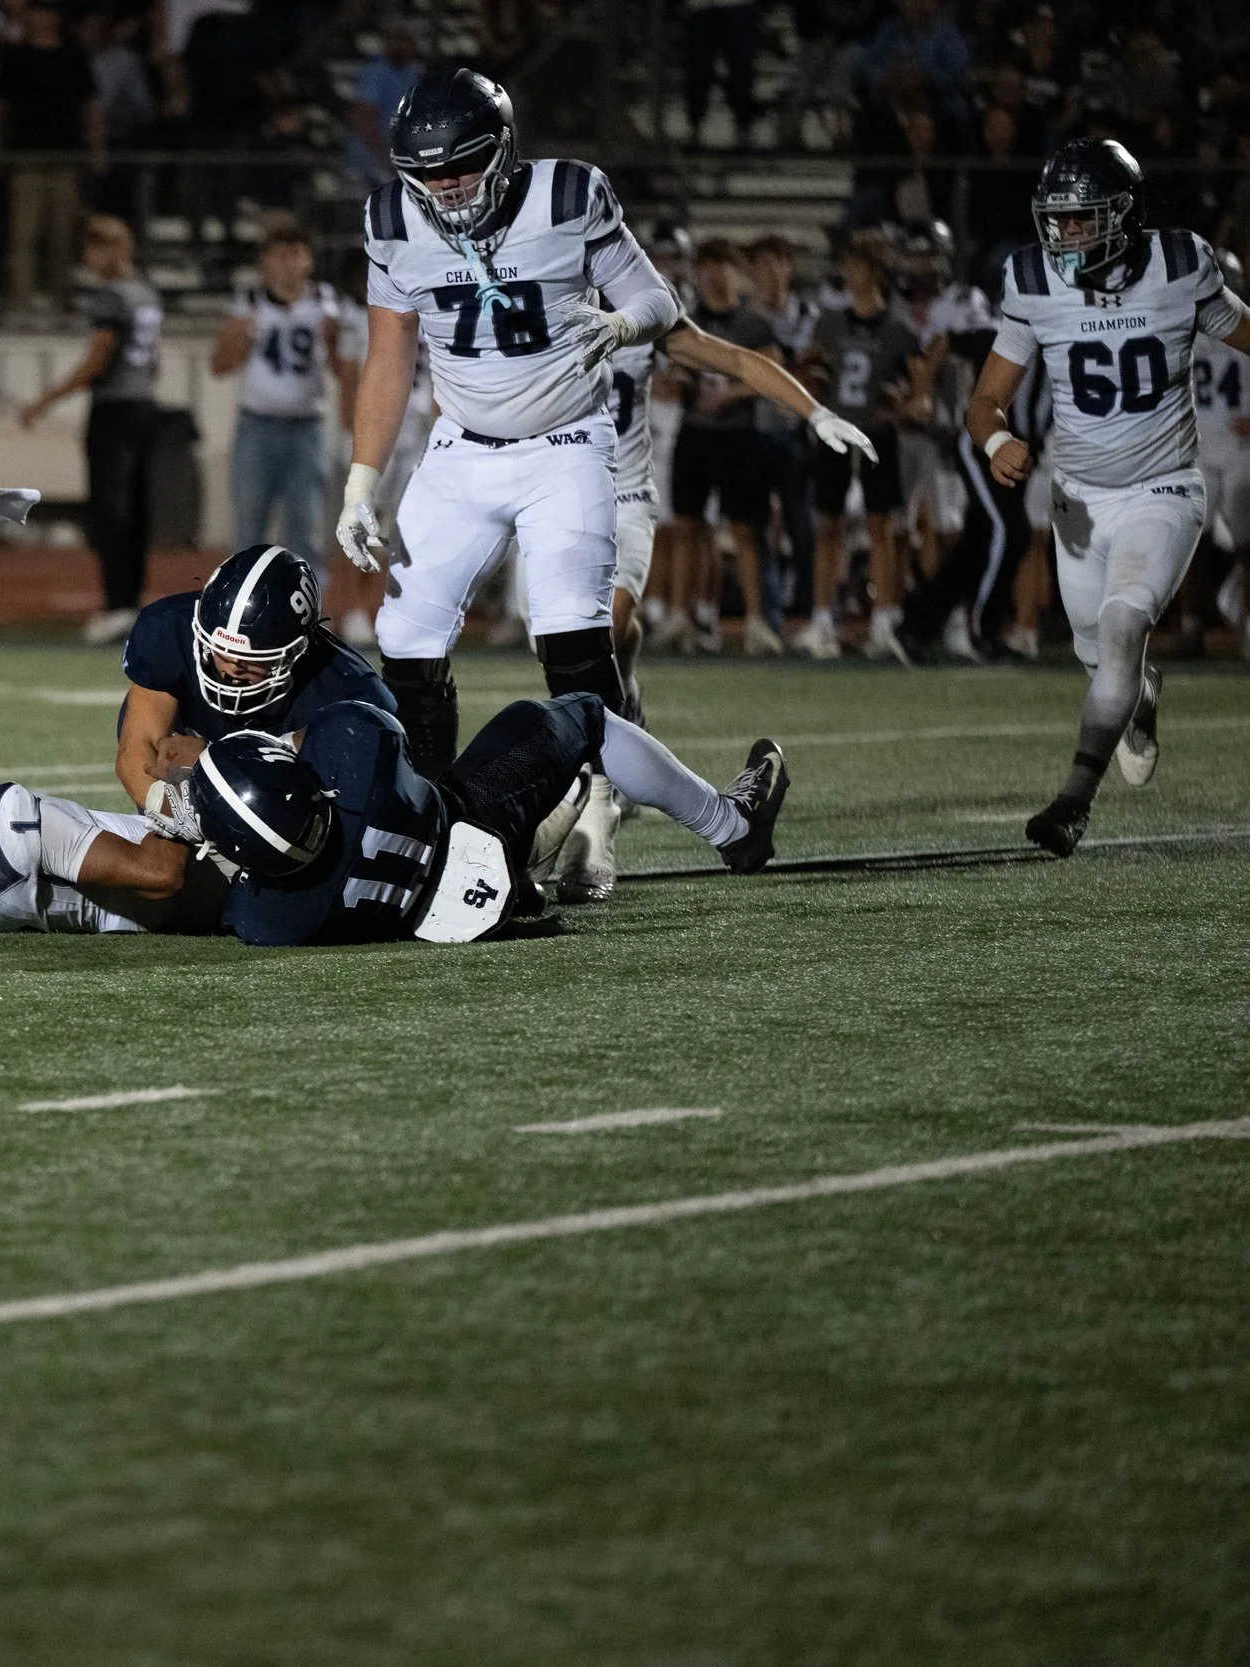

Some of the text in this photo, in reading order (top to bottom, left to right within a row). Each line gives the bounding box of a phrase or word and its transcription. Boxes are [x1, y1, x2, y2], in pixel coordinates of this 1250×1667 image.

[445, 266, 518, 284] CHAPION
[432, 280, 551, 358] 78
[1080, 317, 1147, 333] CHAMPION
[264, 326, 313, 375] 49
[837, 350, 871, 407] 2
[1068, 335, 1169, 417] 60
[217, 630, 246, 645] Riddell
[10, 820, 41, 834] 1
[342, 825, 433, 909] 11
[462, 878, 499, 910] SV
